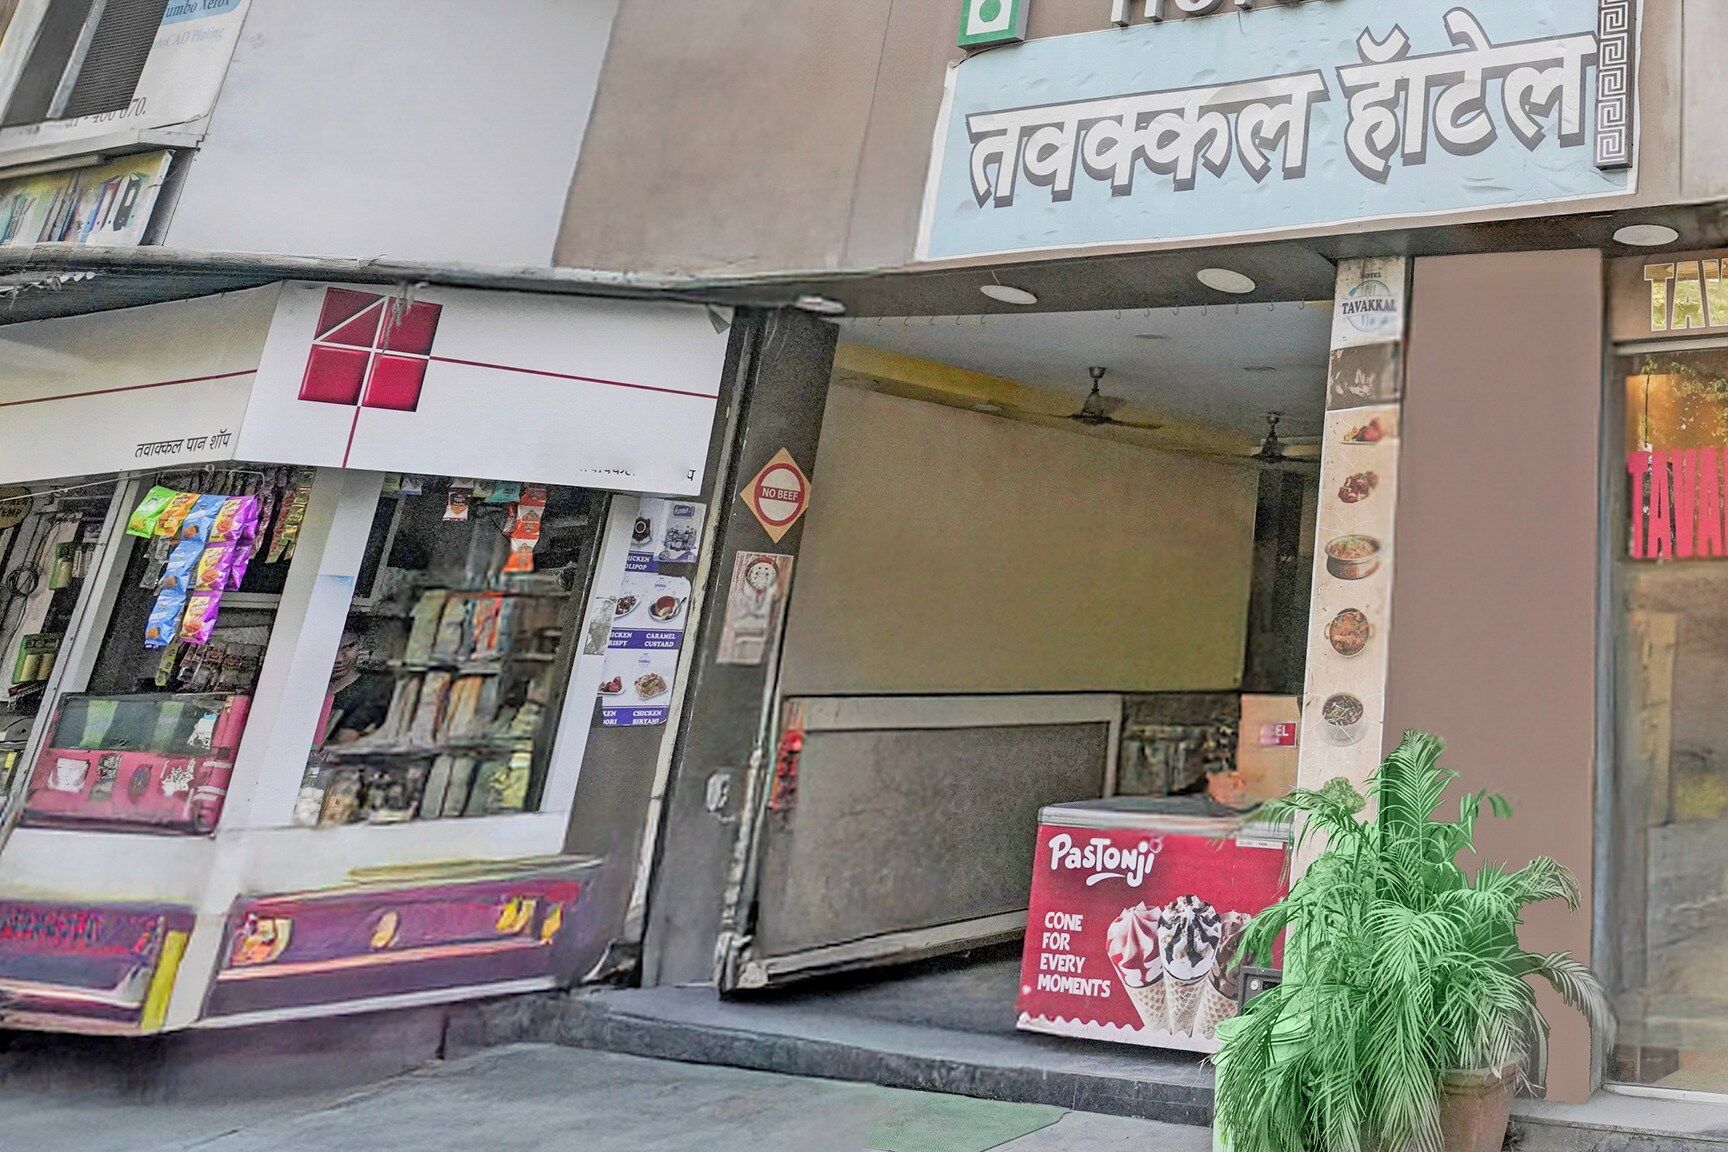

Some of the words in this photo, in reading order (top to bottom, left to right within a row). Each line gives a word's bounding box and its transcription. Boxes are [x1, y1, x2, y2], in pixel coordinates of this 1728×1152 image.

[166, 2, 196, 18] umbo
[965, 69, 1329, 207] तवक्कल
[1342, 299, 1397, 315] TAVAKKAL
[186, 436, 208, 451] पान
[209, 429, 231, 450] शॉप
[762, 486, 776, 498] NO
[778, 489, 799, 501] BEEF
[1044, 911, 1083, 932] CONE
[1042, 932, 1070, 951] FOR
[1039, 954, 1086, 973] EVERY
[1037, 973, 1111, 998] MOMENTS
